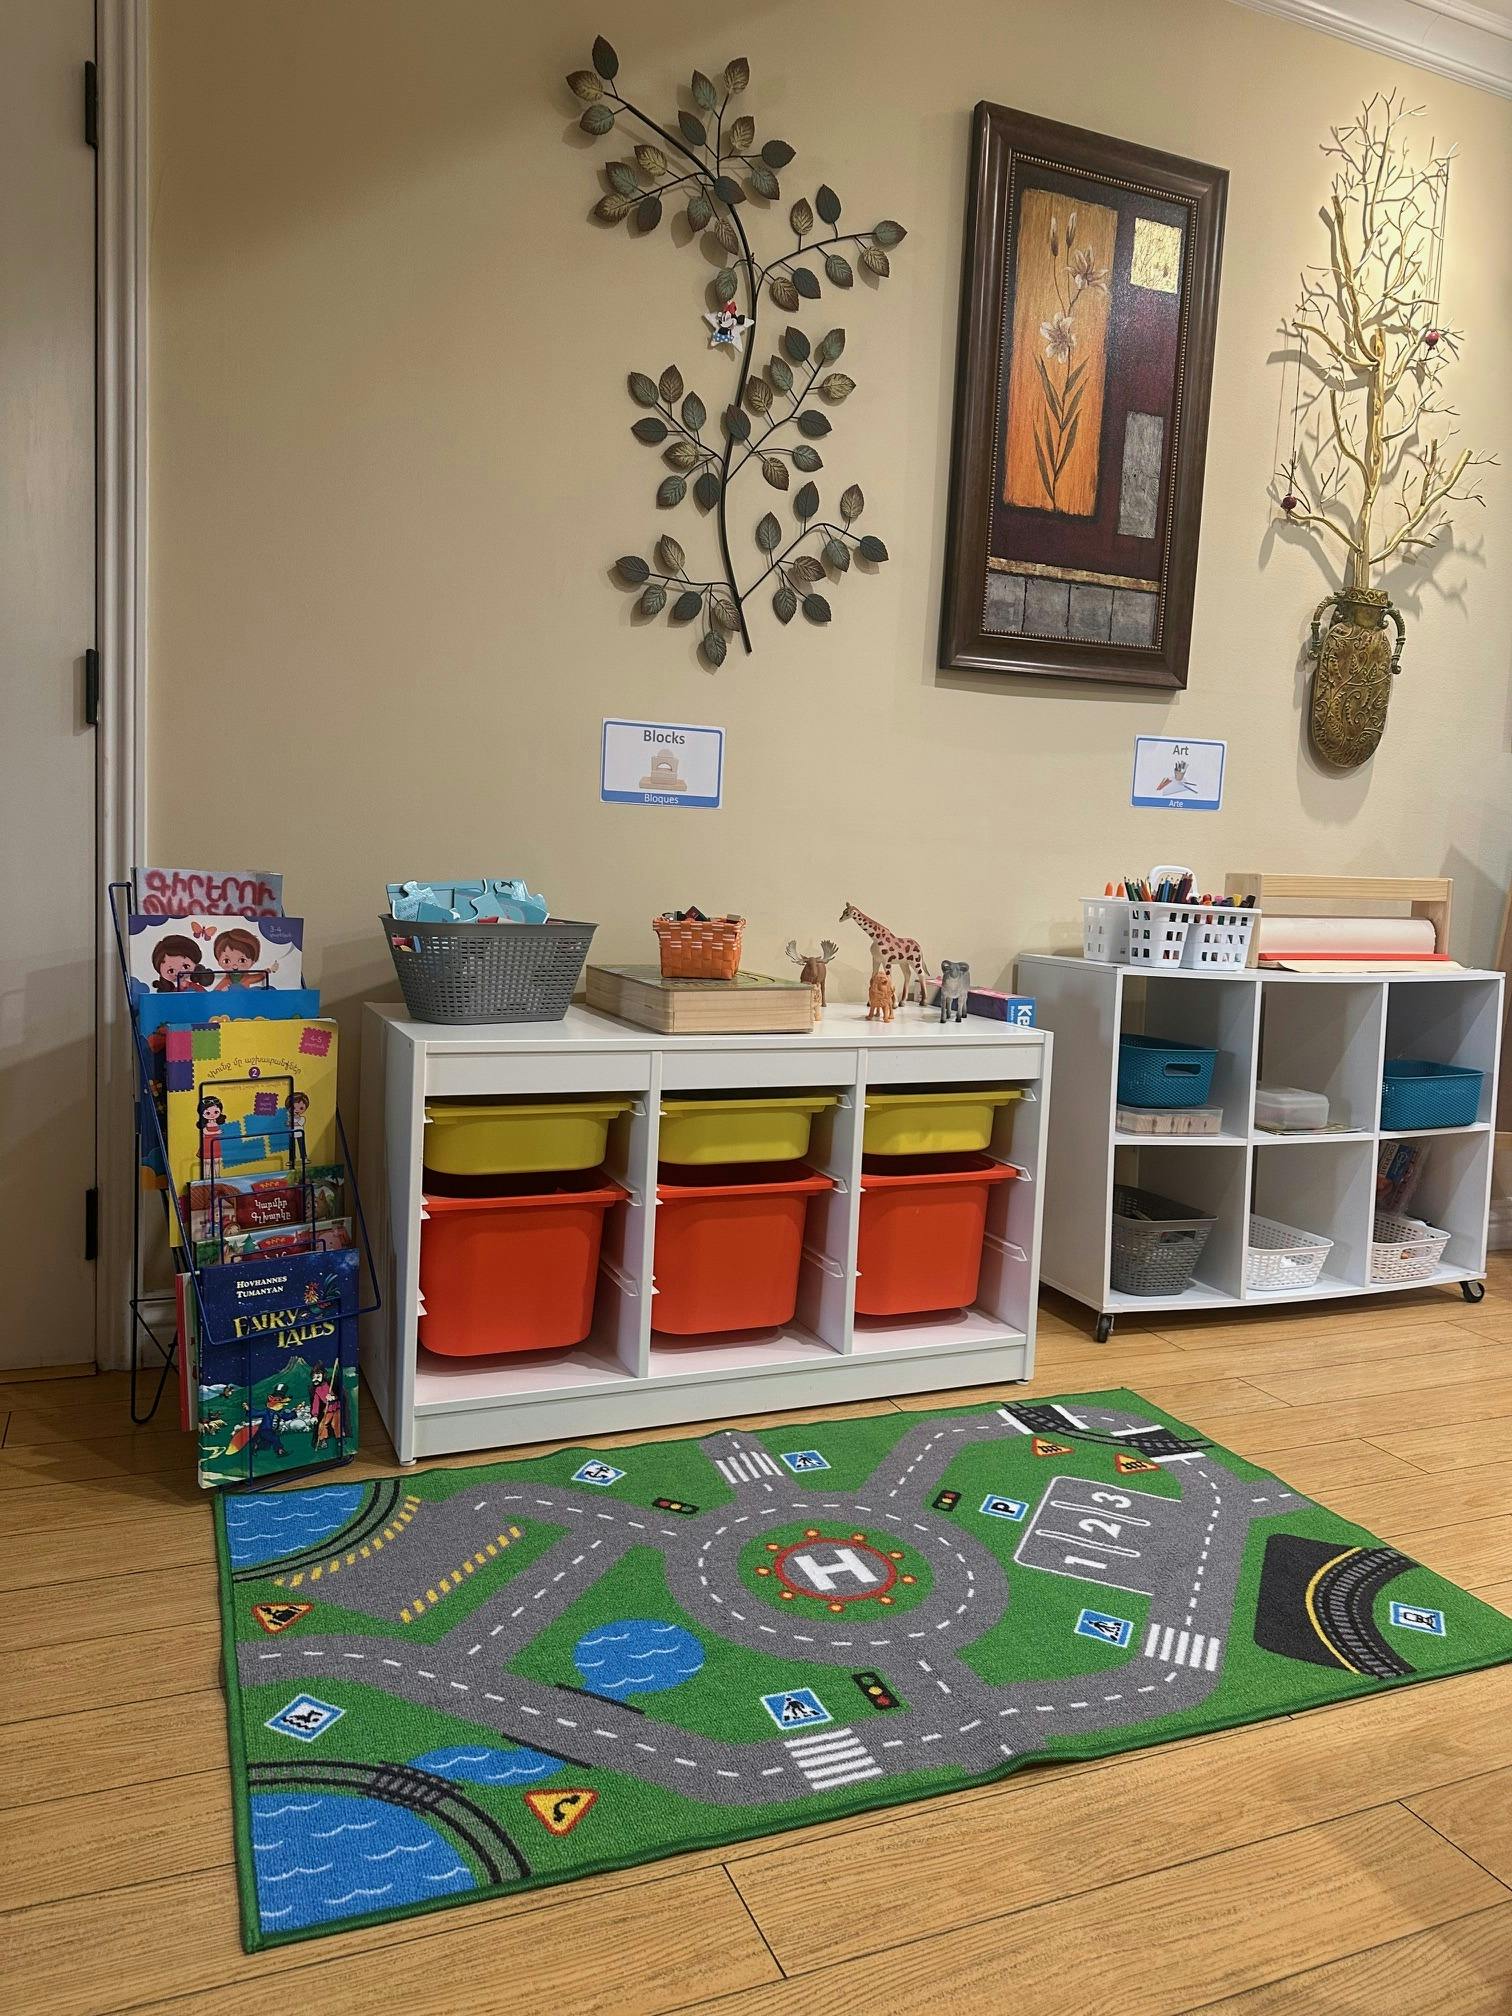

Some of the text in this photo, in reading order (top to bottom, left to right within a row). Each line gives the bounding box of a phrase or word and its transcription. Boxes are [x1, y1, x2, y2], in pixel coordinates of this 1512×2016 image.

[643, 730, 686, 745] Blocks
[1173, 745, 1189, 756] Art
[644, 794, 679, 806] Bloques
[1169, 800, 1183, 808] Arte
[252, 1069, 258, 1077] 2
[236, 1276, 288, 1289] HOVHANNES
[236, 1286, 284, 1299] TUMANYAN
[233, 1308, 299, 1338] FAIRY
[277, 1321, 336, 1349] TALES
[1091, 1491, 1132, 1509] 3
[990, 1502, 1017, 1514] P
[1078, 1518, 1122, 1539] 2
[794, 1548, 879, 1591] H
[1064, 1555, 1107, 1570] 1
